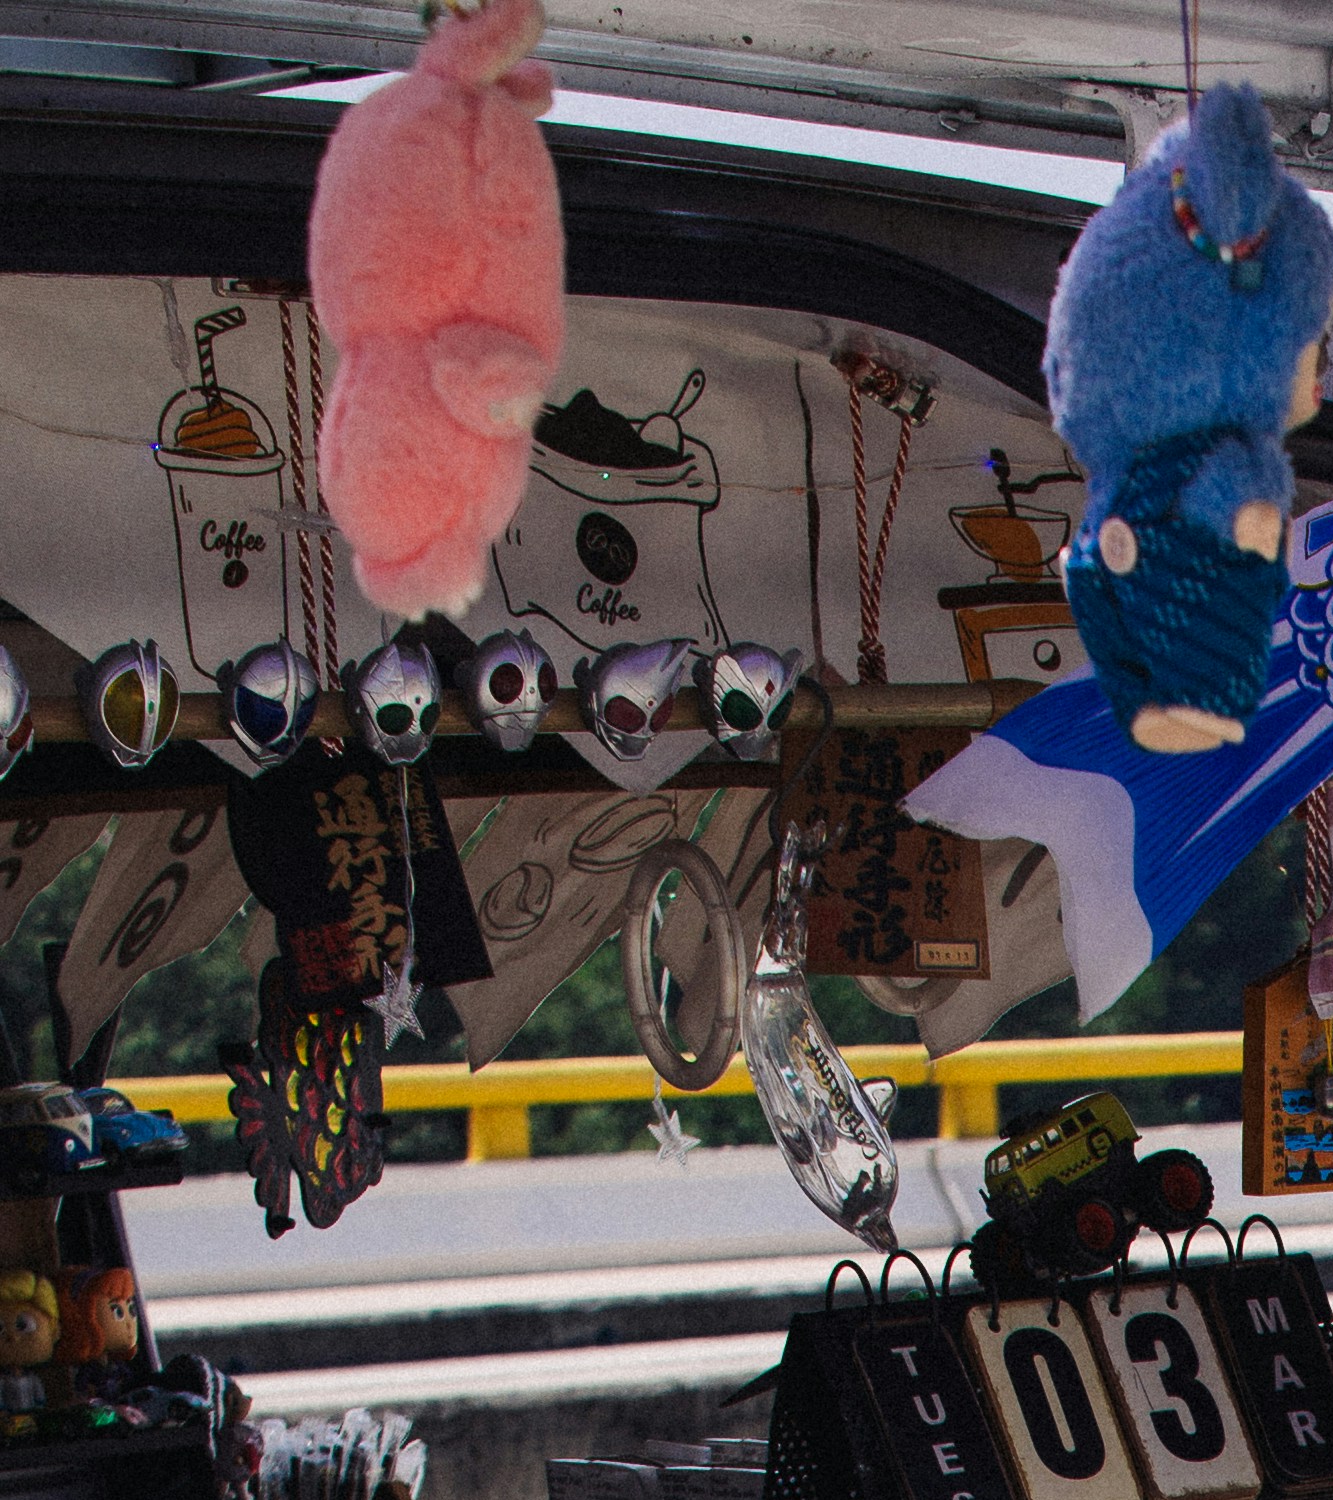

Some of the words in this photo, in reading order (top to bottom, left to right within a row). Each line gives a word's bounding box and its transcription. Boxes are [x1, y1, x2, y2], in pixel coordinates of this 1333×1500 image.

[201, 520, 266, 559] Coffee
[576, 583, 642, 622] Coffee
[1246, 1297, 1328, 1447] MAR
